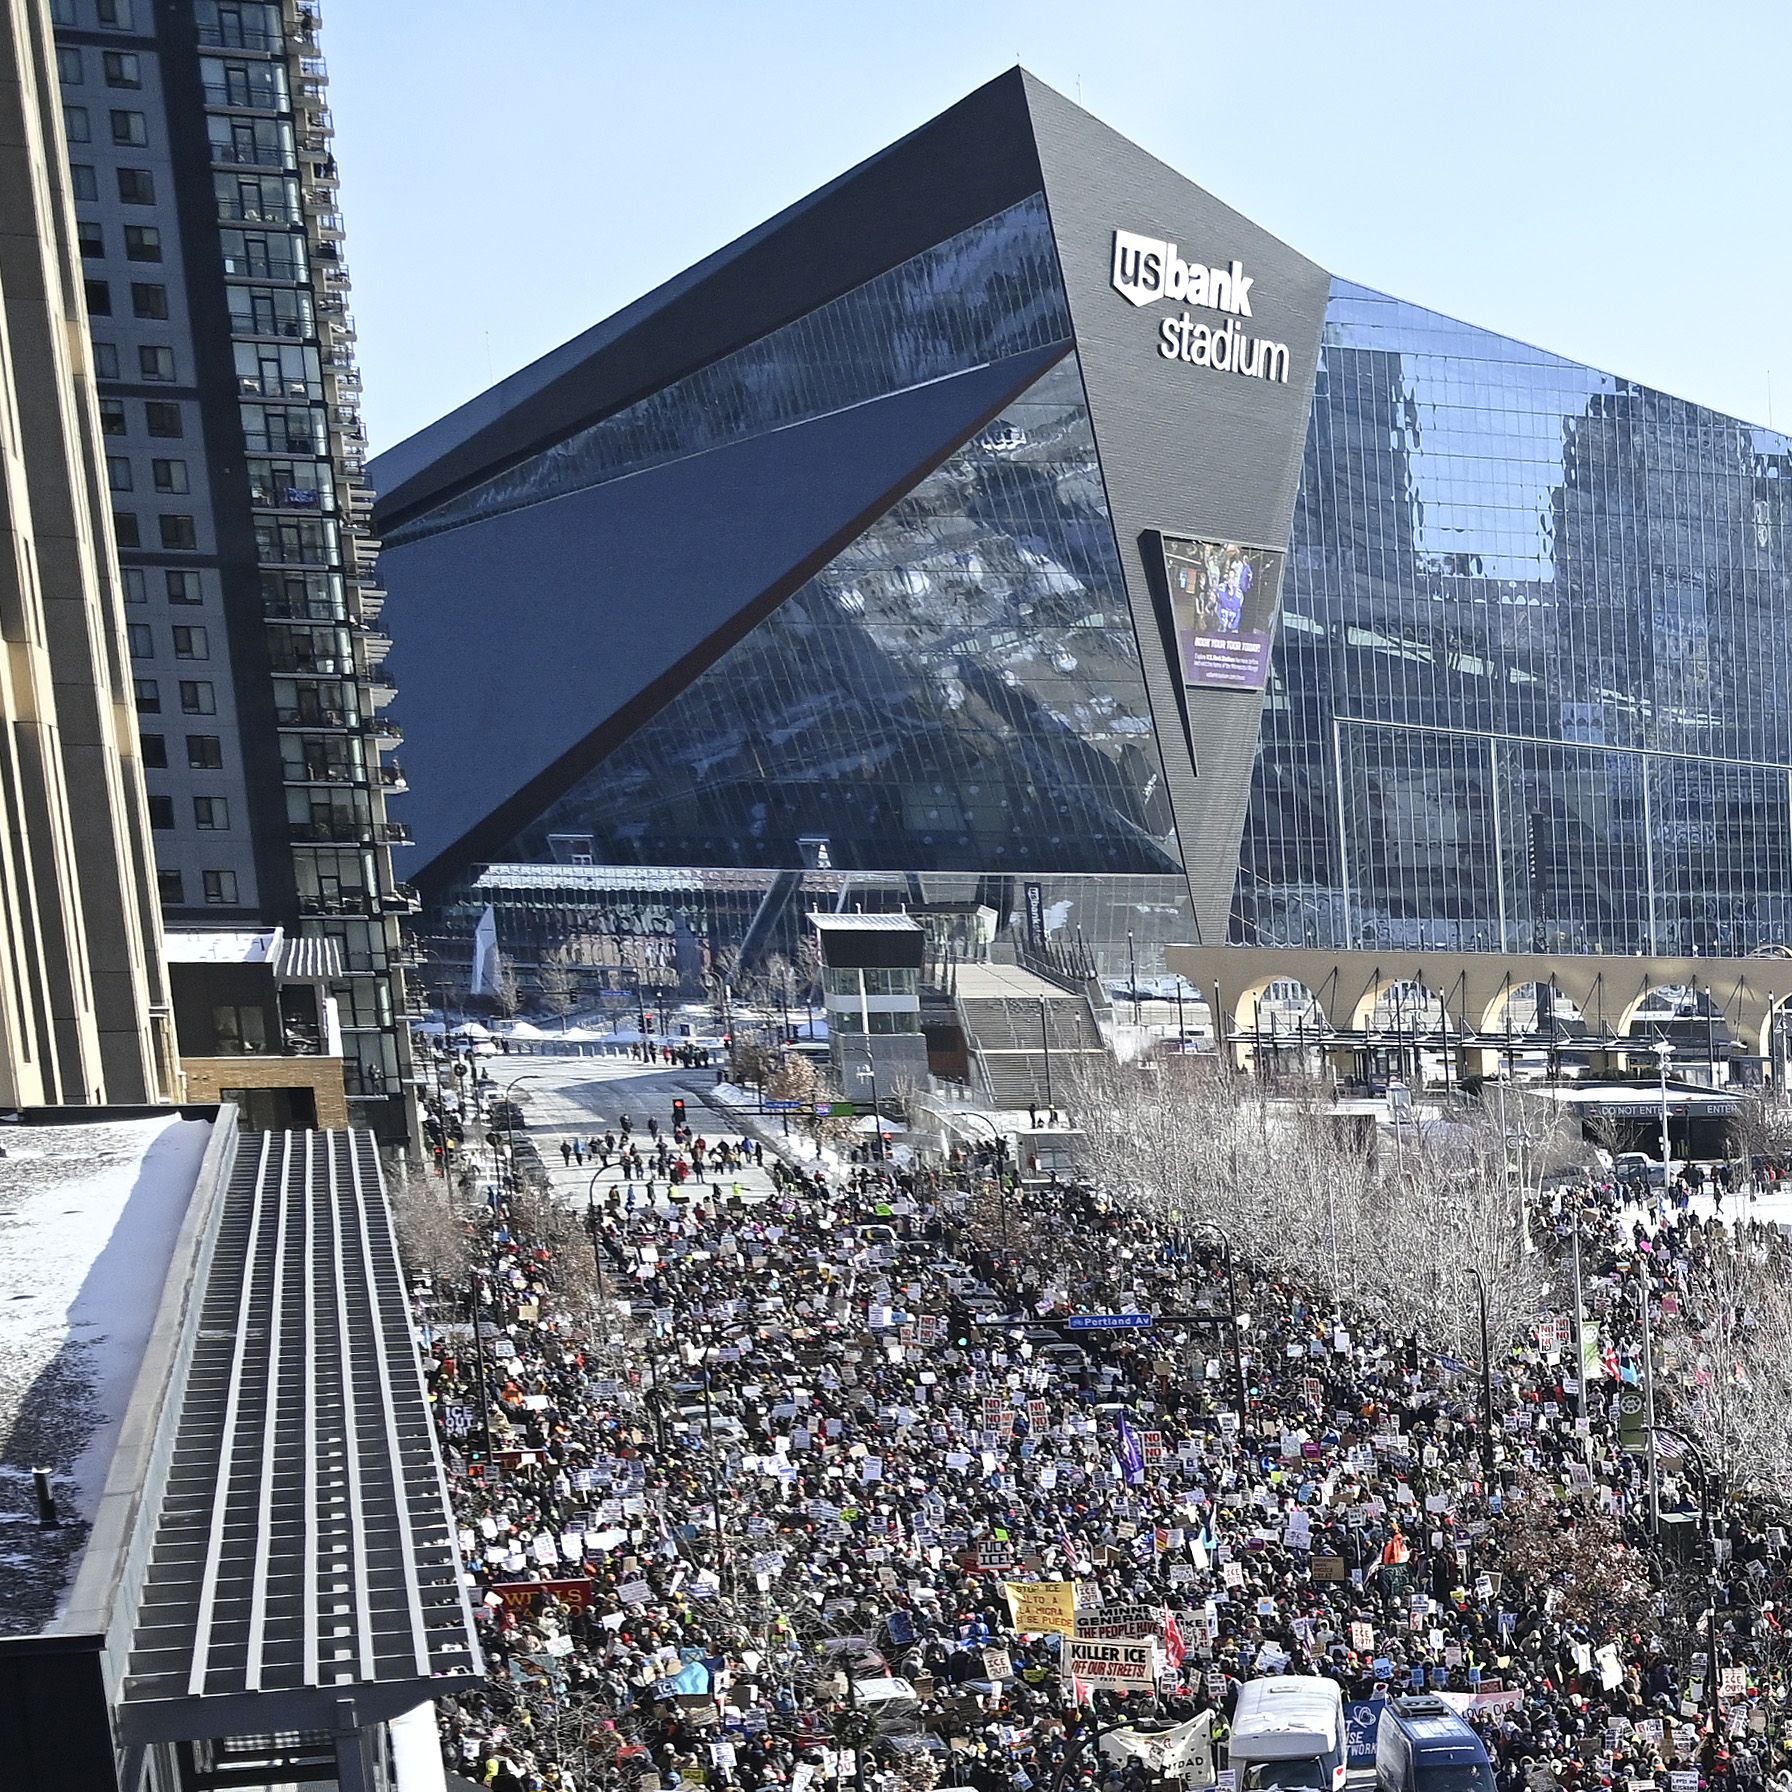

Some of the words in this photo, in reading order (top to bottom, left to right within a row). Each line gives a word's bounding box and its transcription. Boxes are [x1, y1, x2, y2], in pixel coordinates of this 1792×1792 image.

[1161, 315, 1289, 383] stadium
[1617, 1105, 1637, 1115] NOT
[1084, 1314, 1132, 1327] Portland
[1135, 1313, 1150, 1325] Av
[1144, 1433, 1161, 1443] NO
[1145, 1448, 1162, 1457] NO
[980, 1542, 1008, 1553] FUCK
[1079, 1627, 1097, 1639] THE
[1100, 1625, 1134, 1639] PEOPLE
[1072, 1646, 1113, 1661] KILLER
[1120, 1646, 1146, 1662] ICE
[1090, 1661, 1108, 1674] OUR
